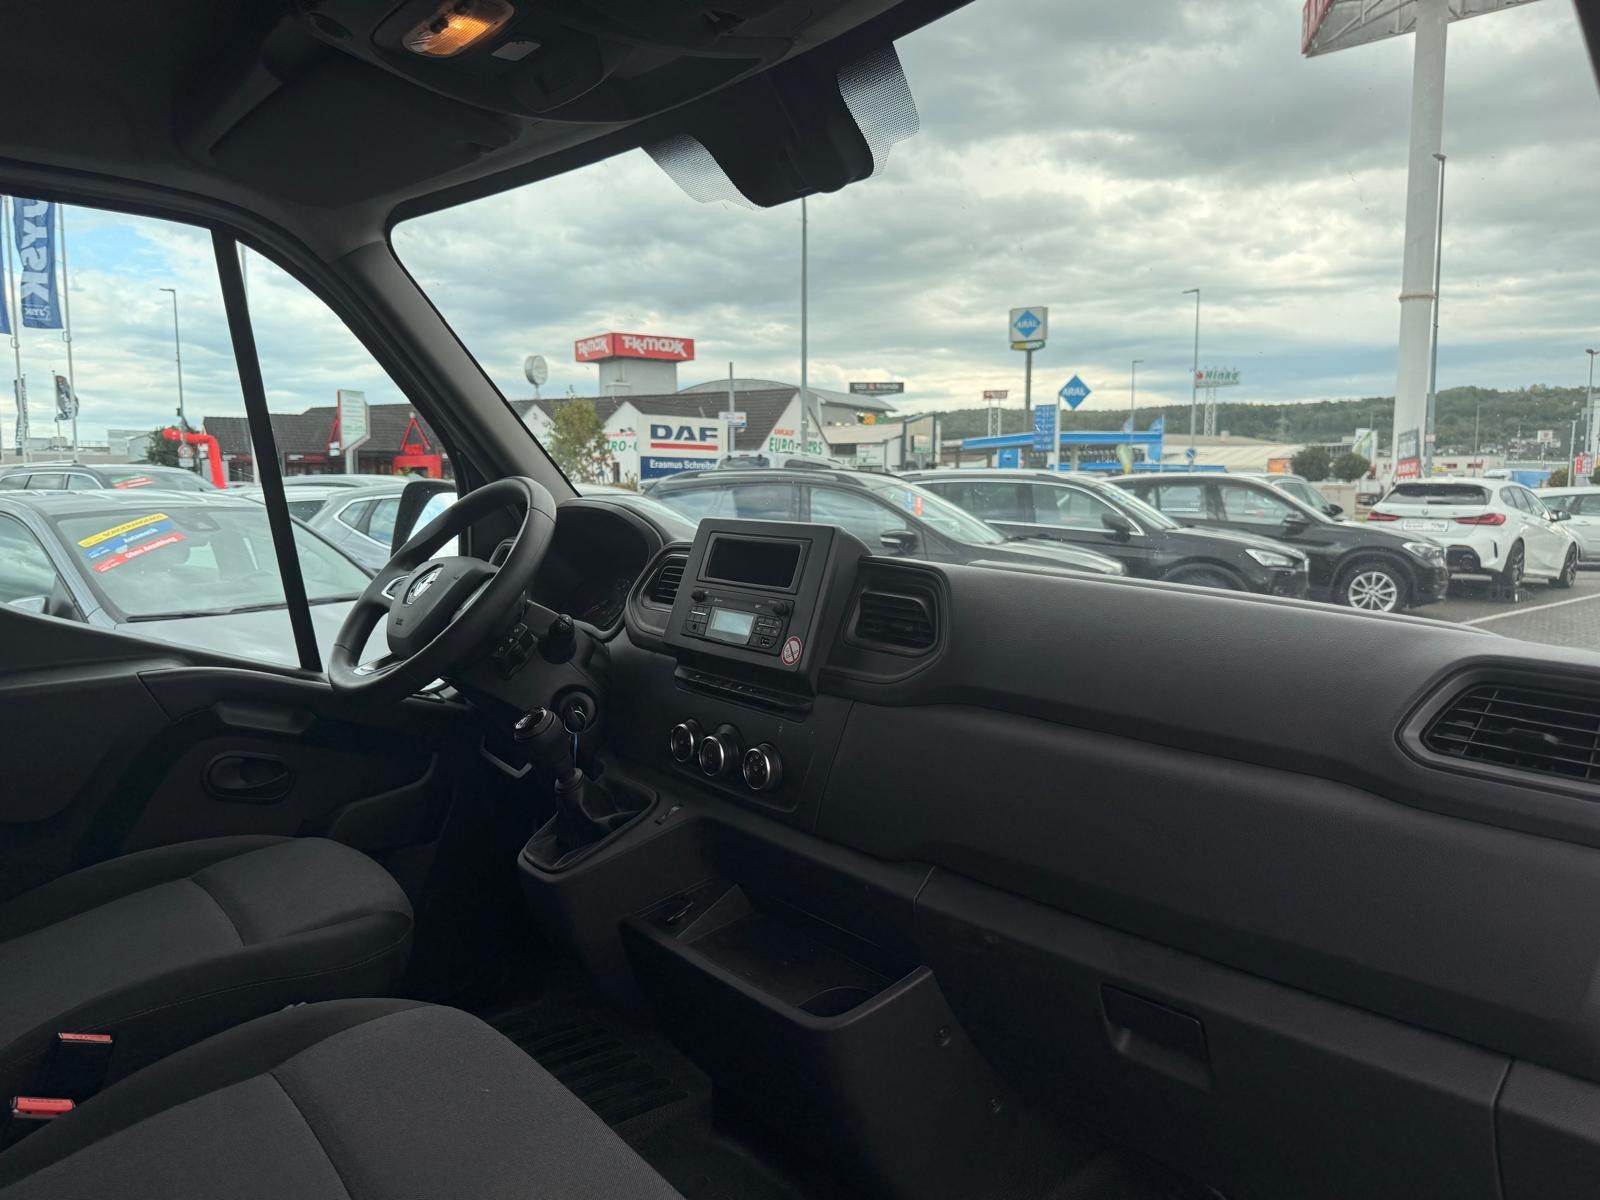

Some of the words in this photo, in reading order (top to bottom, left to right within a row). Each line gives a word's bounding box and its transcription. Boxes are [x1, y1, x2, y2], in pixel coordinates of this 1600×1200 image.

[1062, 386, 1085, 396] ARAL
[650, 424, 719, 442] DAF
[650, 459, 683, 469] Erasmus
